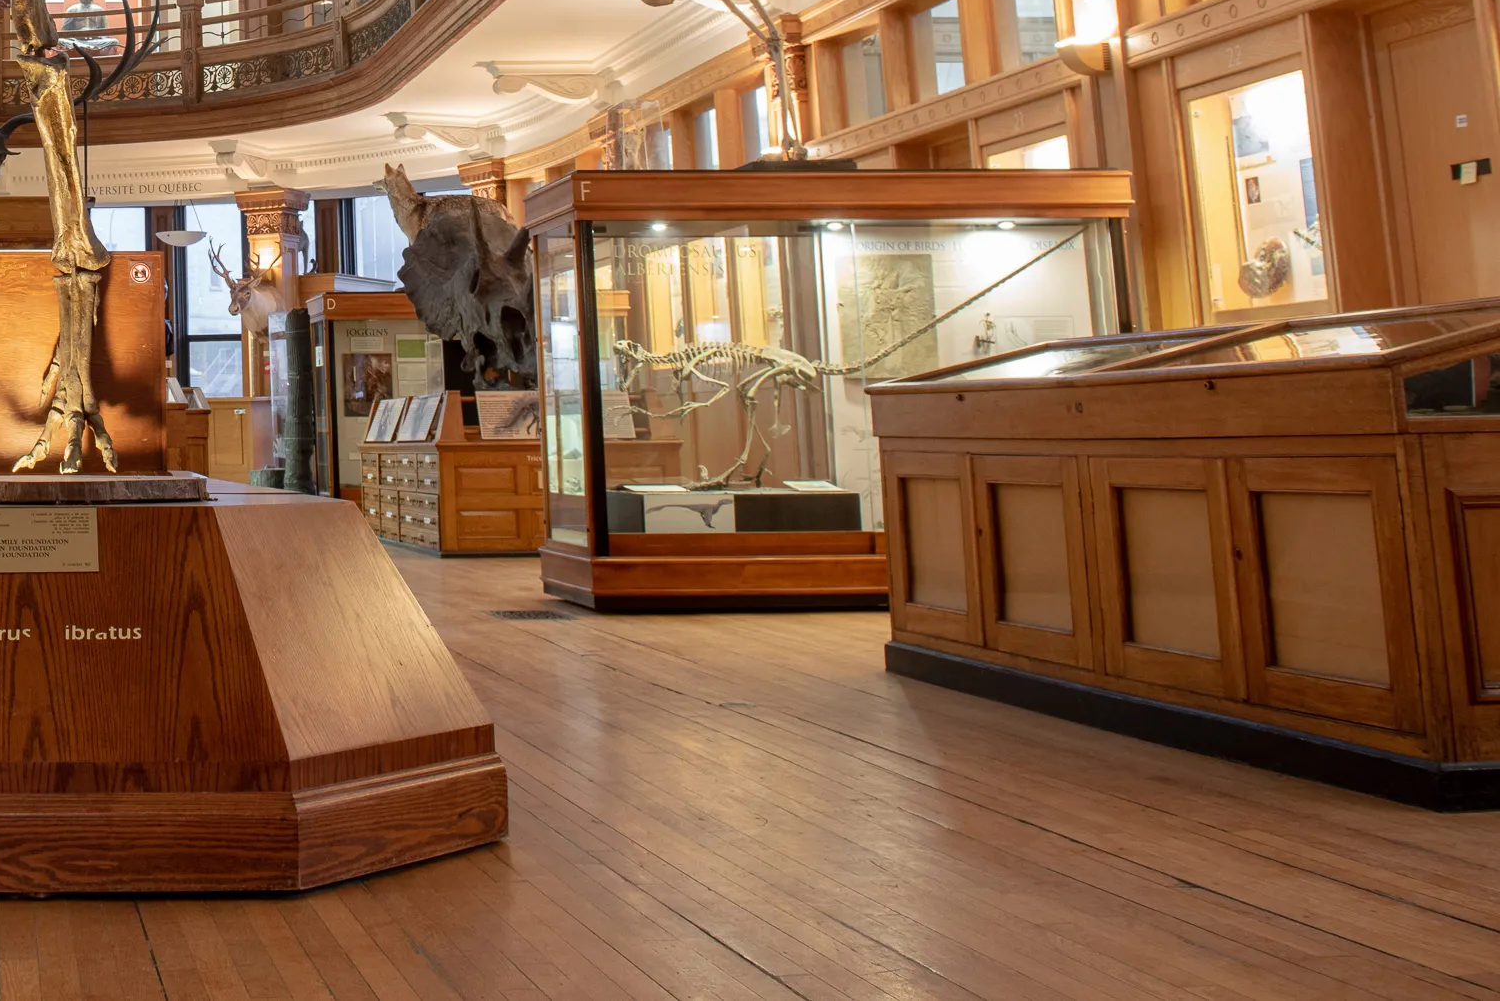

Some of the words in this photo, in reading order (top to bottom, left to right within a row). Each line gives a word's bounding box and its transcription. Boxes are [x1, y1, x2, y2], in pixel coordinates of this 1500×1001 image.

[1227, 45, 1243, 69] 22
[1013, 111, 1025, 131] 21
[84, 184, 134, 196] IVERSITÉ
[139, 184, 155, 194] DU
[158, 181, 202, 194] QUÉBEC
[580, 181, 591, 202] F
[856, 241, 895, 251] ORIGIN
[897, 241, 913, 250] OF
[914, 241, 945, 250] BIRDS
[326, 298, 336, 310] D
[346, 328, 388, 338] JOGGINS
